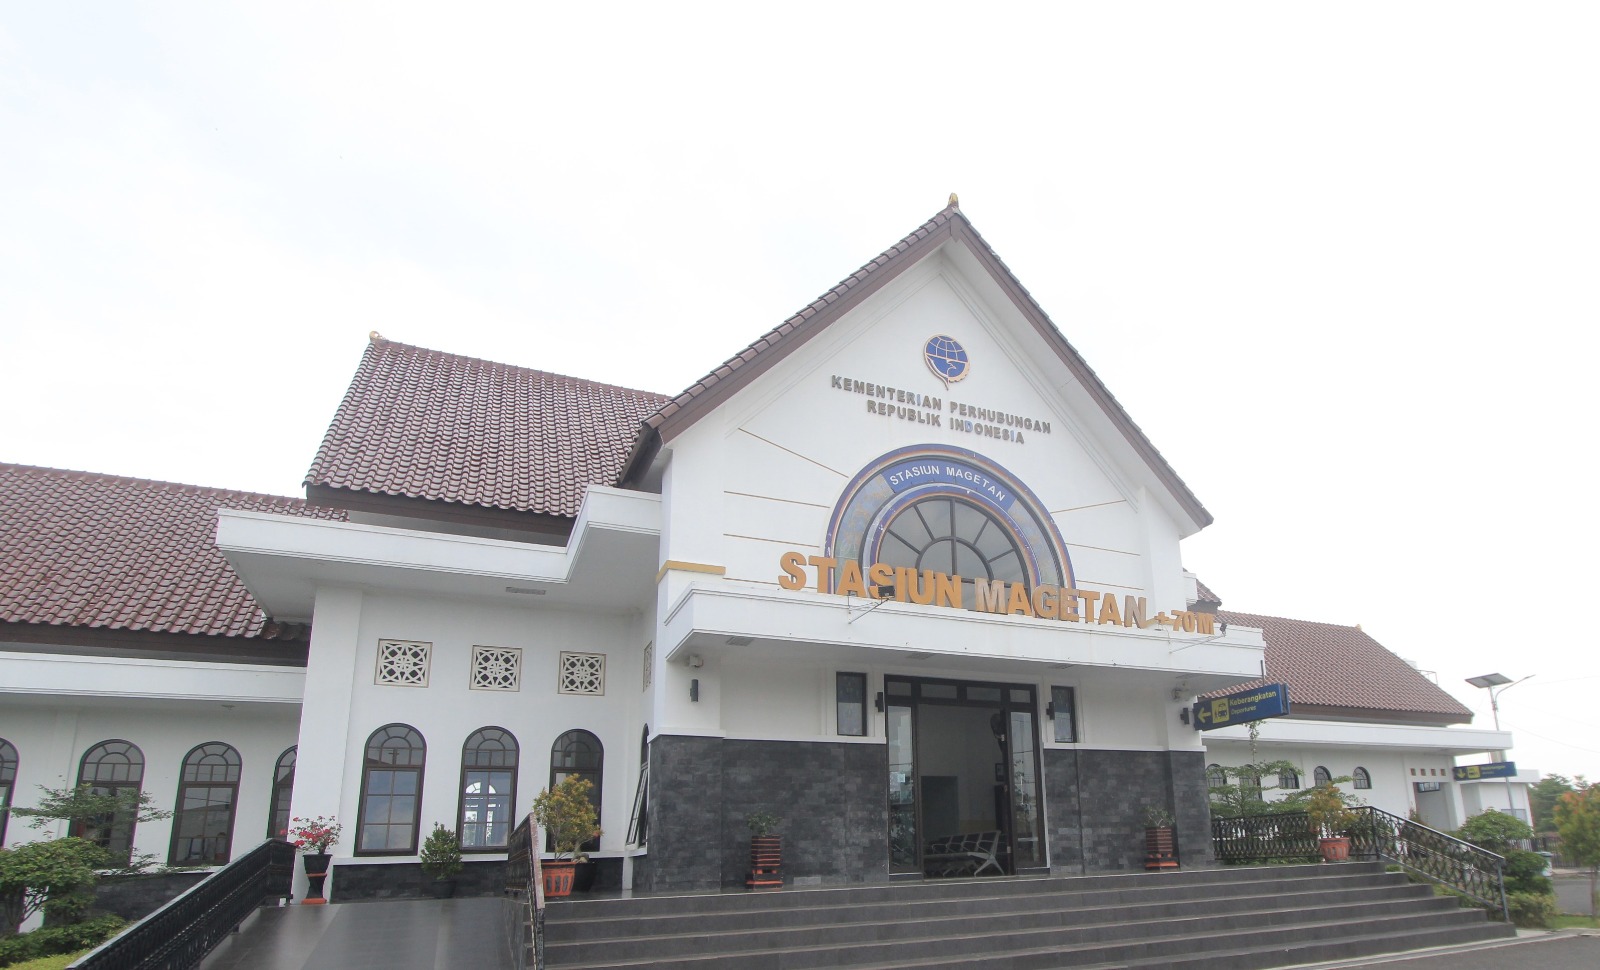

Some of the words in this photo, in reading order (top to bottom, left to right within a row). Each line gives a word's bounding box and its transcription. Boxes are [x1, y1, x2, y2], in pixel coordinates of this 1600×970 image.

[832, 375, 942, 410] KEMENTERIAN
[950, 402, 1051, 433] PERHUBUNGAN
[867, 401, 941, 427] REPUBLIK
[950, 418, 1024, 444] INDONESIA
[890, 465, 940, 485] STASIUN
[946, 467, 1005, 501] MAGETAN
[779, 552, 962, 608] STASIUN
[976, 579, 1147, 629] MAGETAN
[1230, 691, 1277, 705] Keberangkatan
